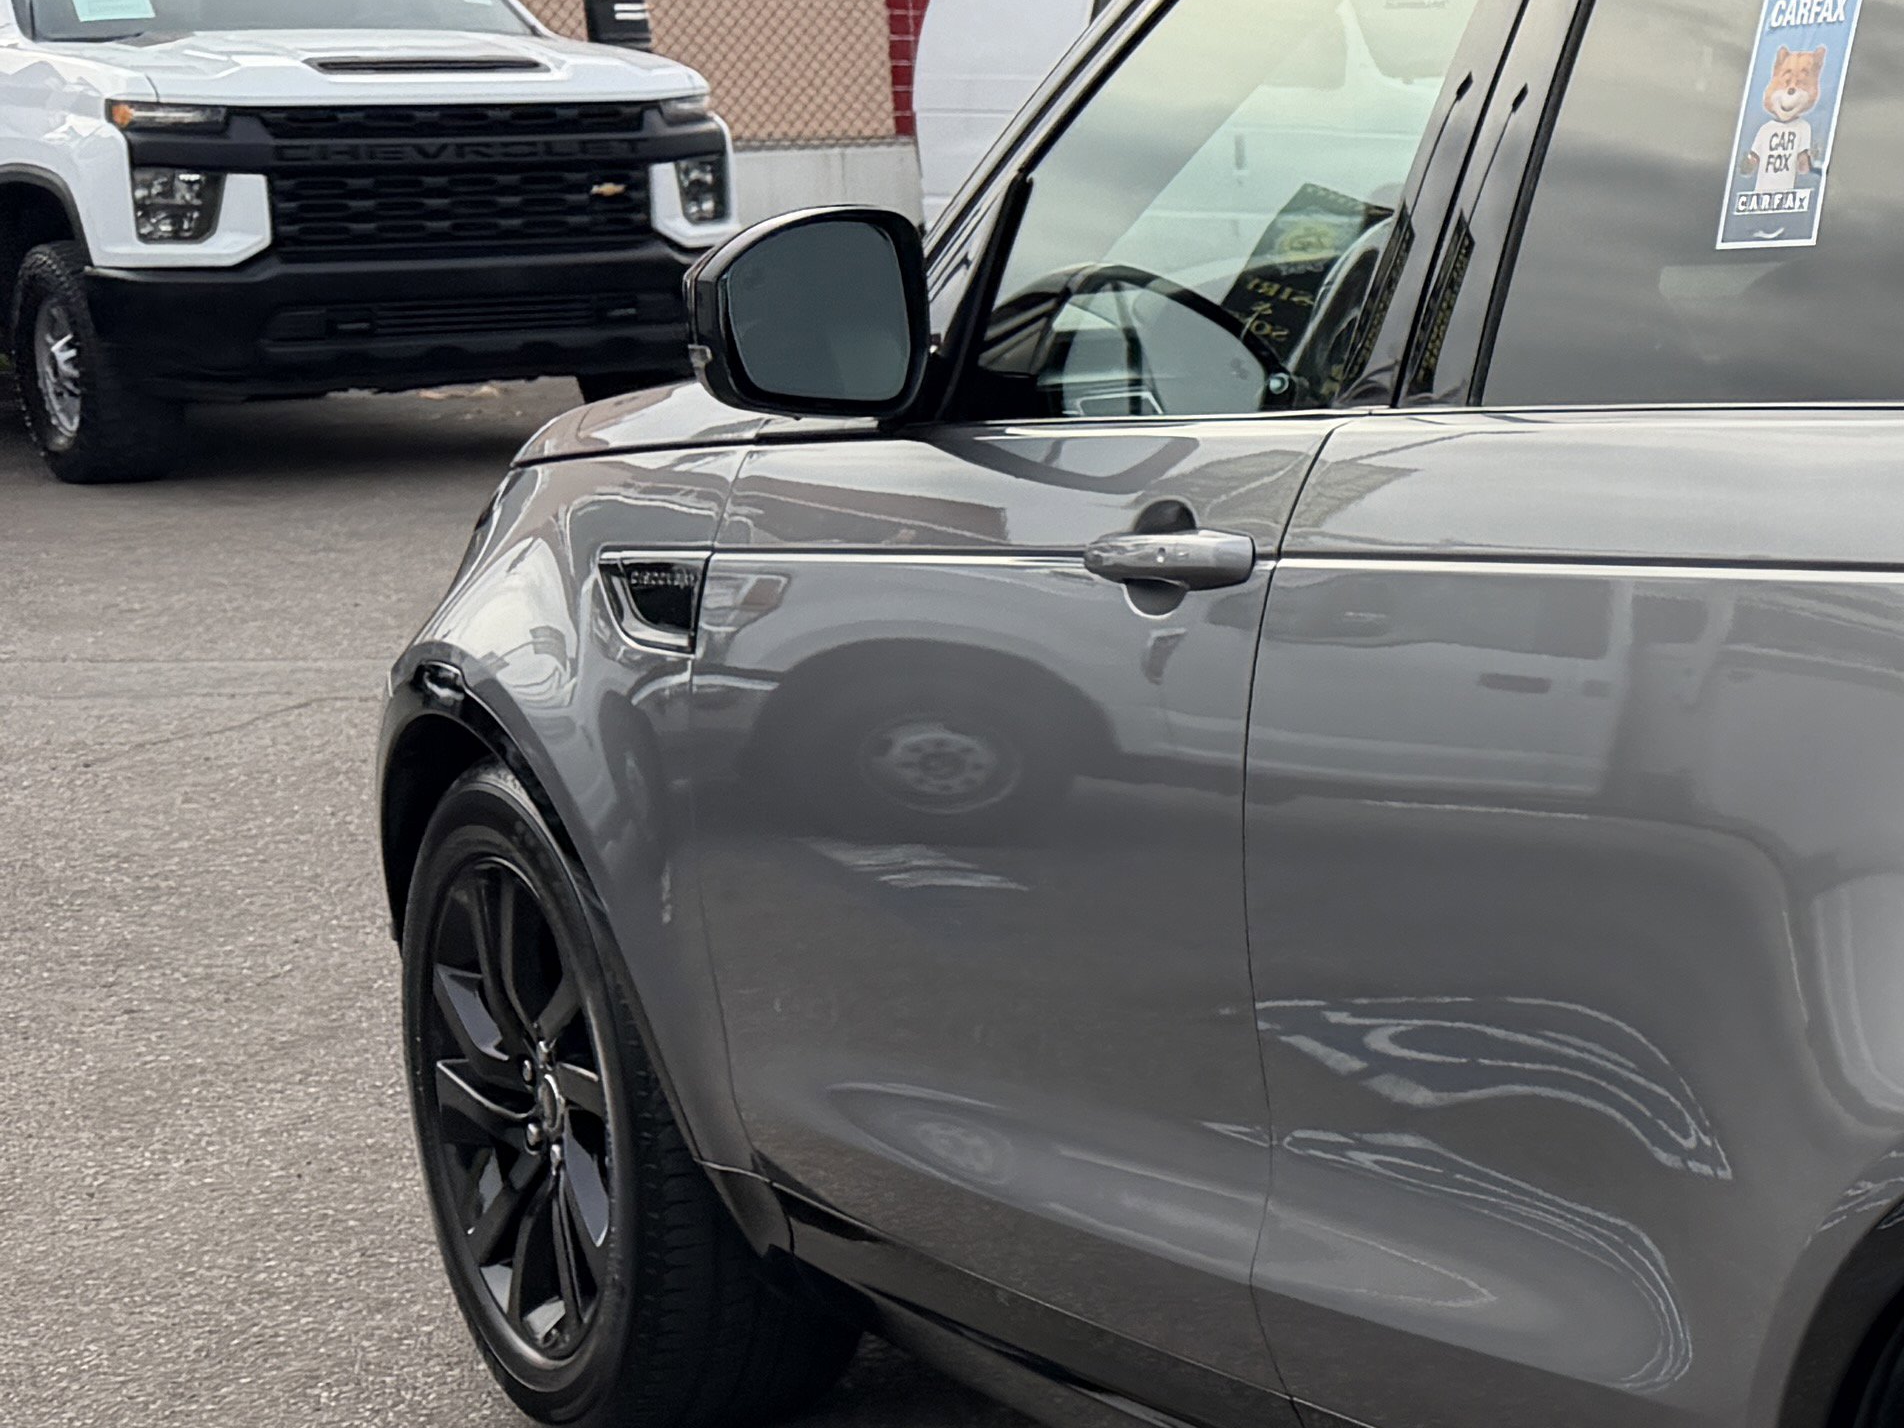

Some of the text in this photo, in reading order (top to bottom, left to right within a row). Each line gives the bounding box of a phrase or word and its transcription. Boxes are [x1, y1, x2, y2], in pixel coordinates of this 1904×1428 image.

[274, 138, 650, 162] CHEVROLET
[1769, 131, 1796, 152] CAR
[1765, 153, 1793, 174] FOX
[1737, 192, 1808, 212] CARFAX
